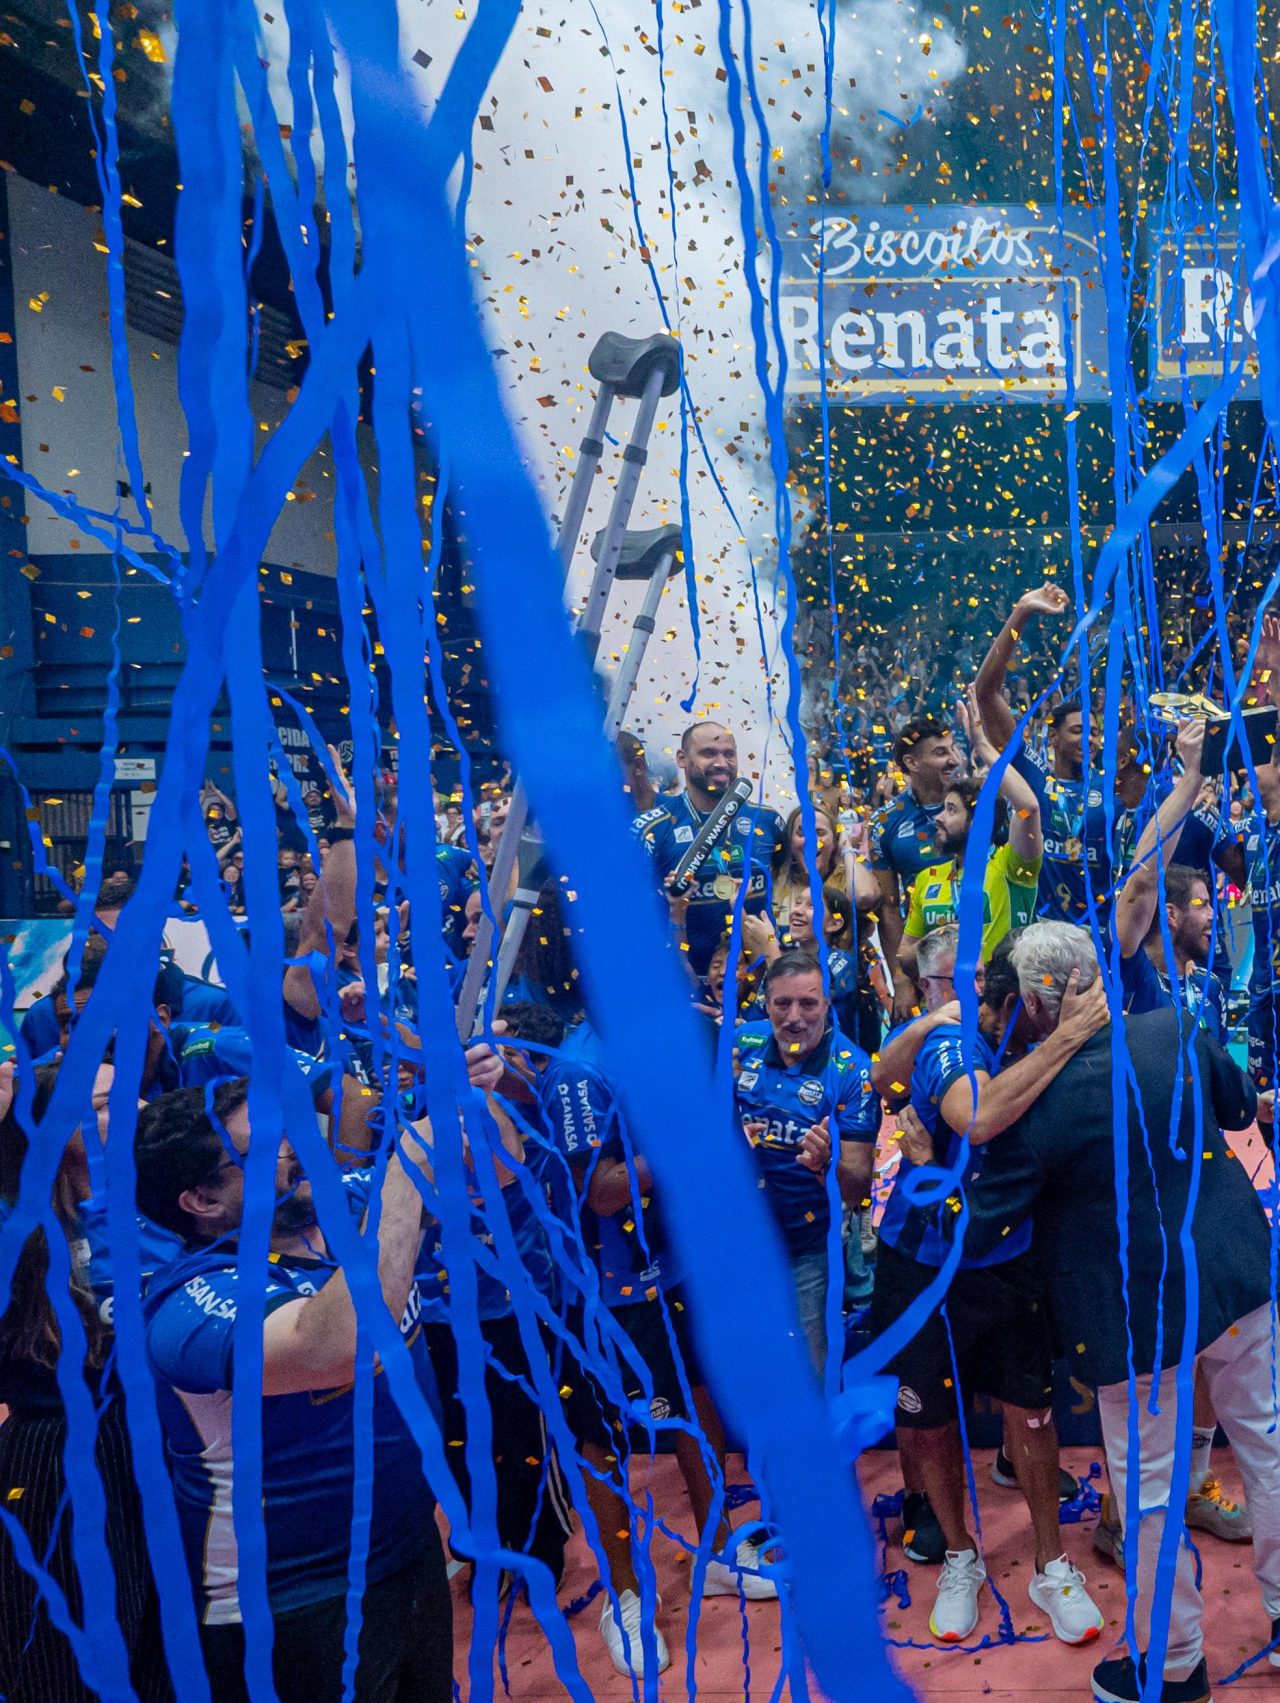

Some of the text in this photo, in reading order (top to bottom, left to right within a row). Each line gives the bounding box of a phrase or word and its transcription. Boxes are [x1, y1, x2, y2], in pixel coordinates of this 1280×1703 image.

[801, 216, 1034, 276] Biscoitos
[779, 296, 1067, 370] Renata
[677, 851, 706, 890] DAHUJ
[561, 1096, 579, 1152] SANASA
[577, 1079, 597, 1133] SANASA
